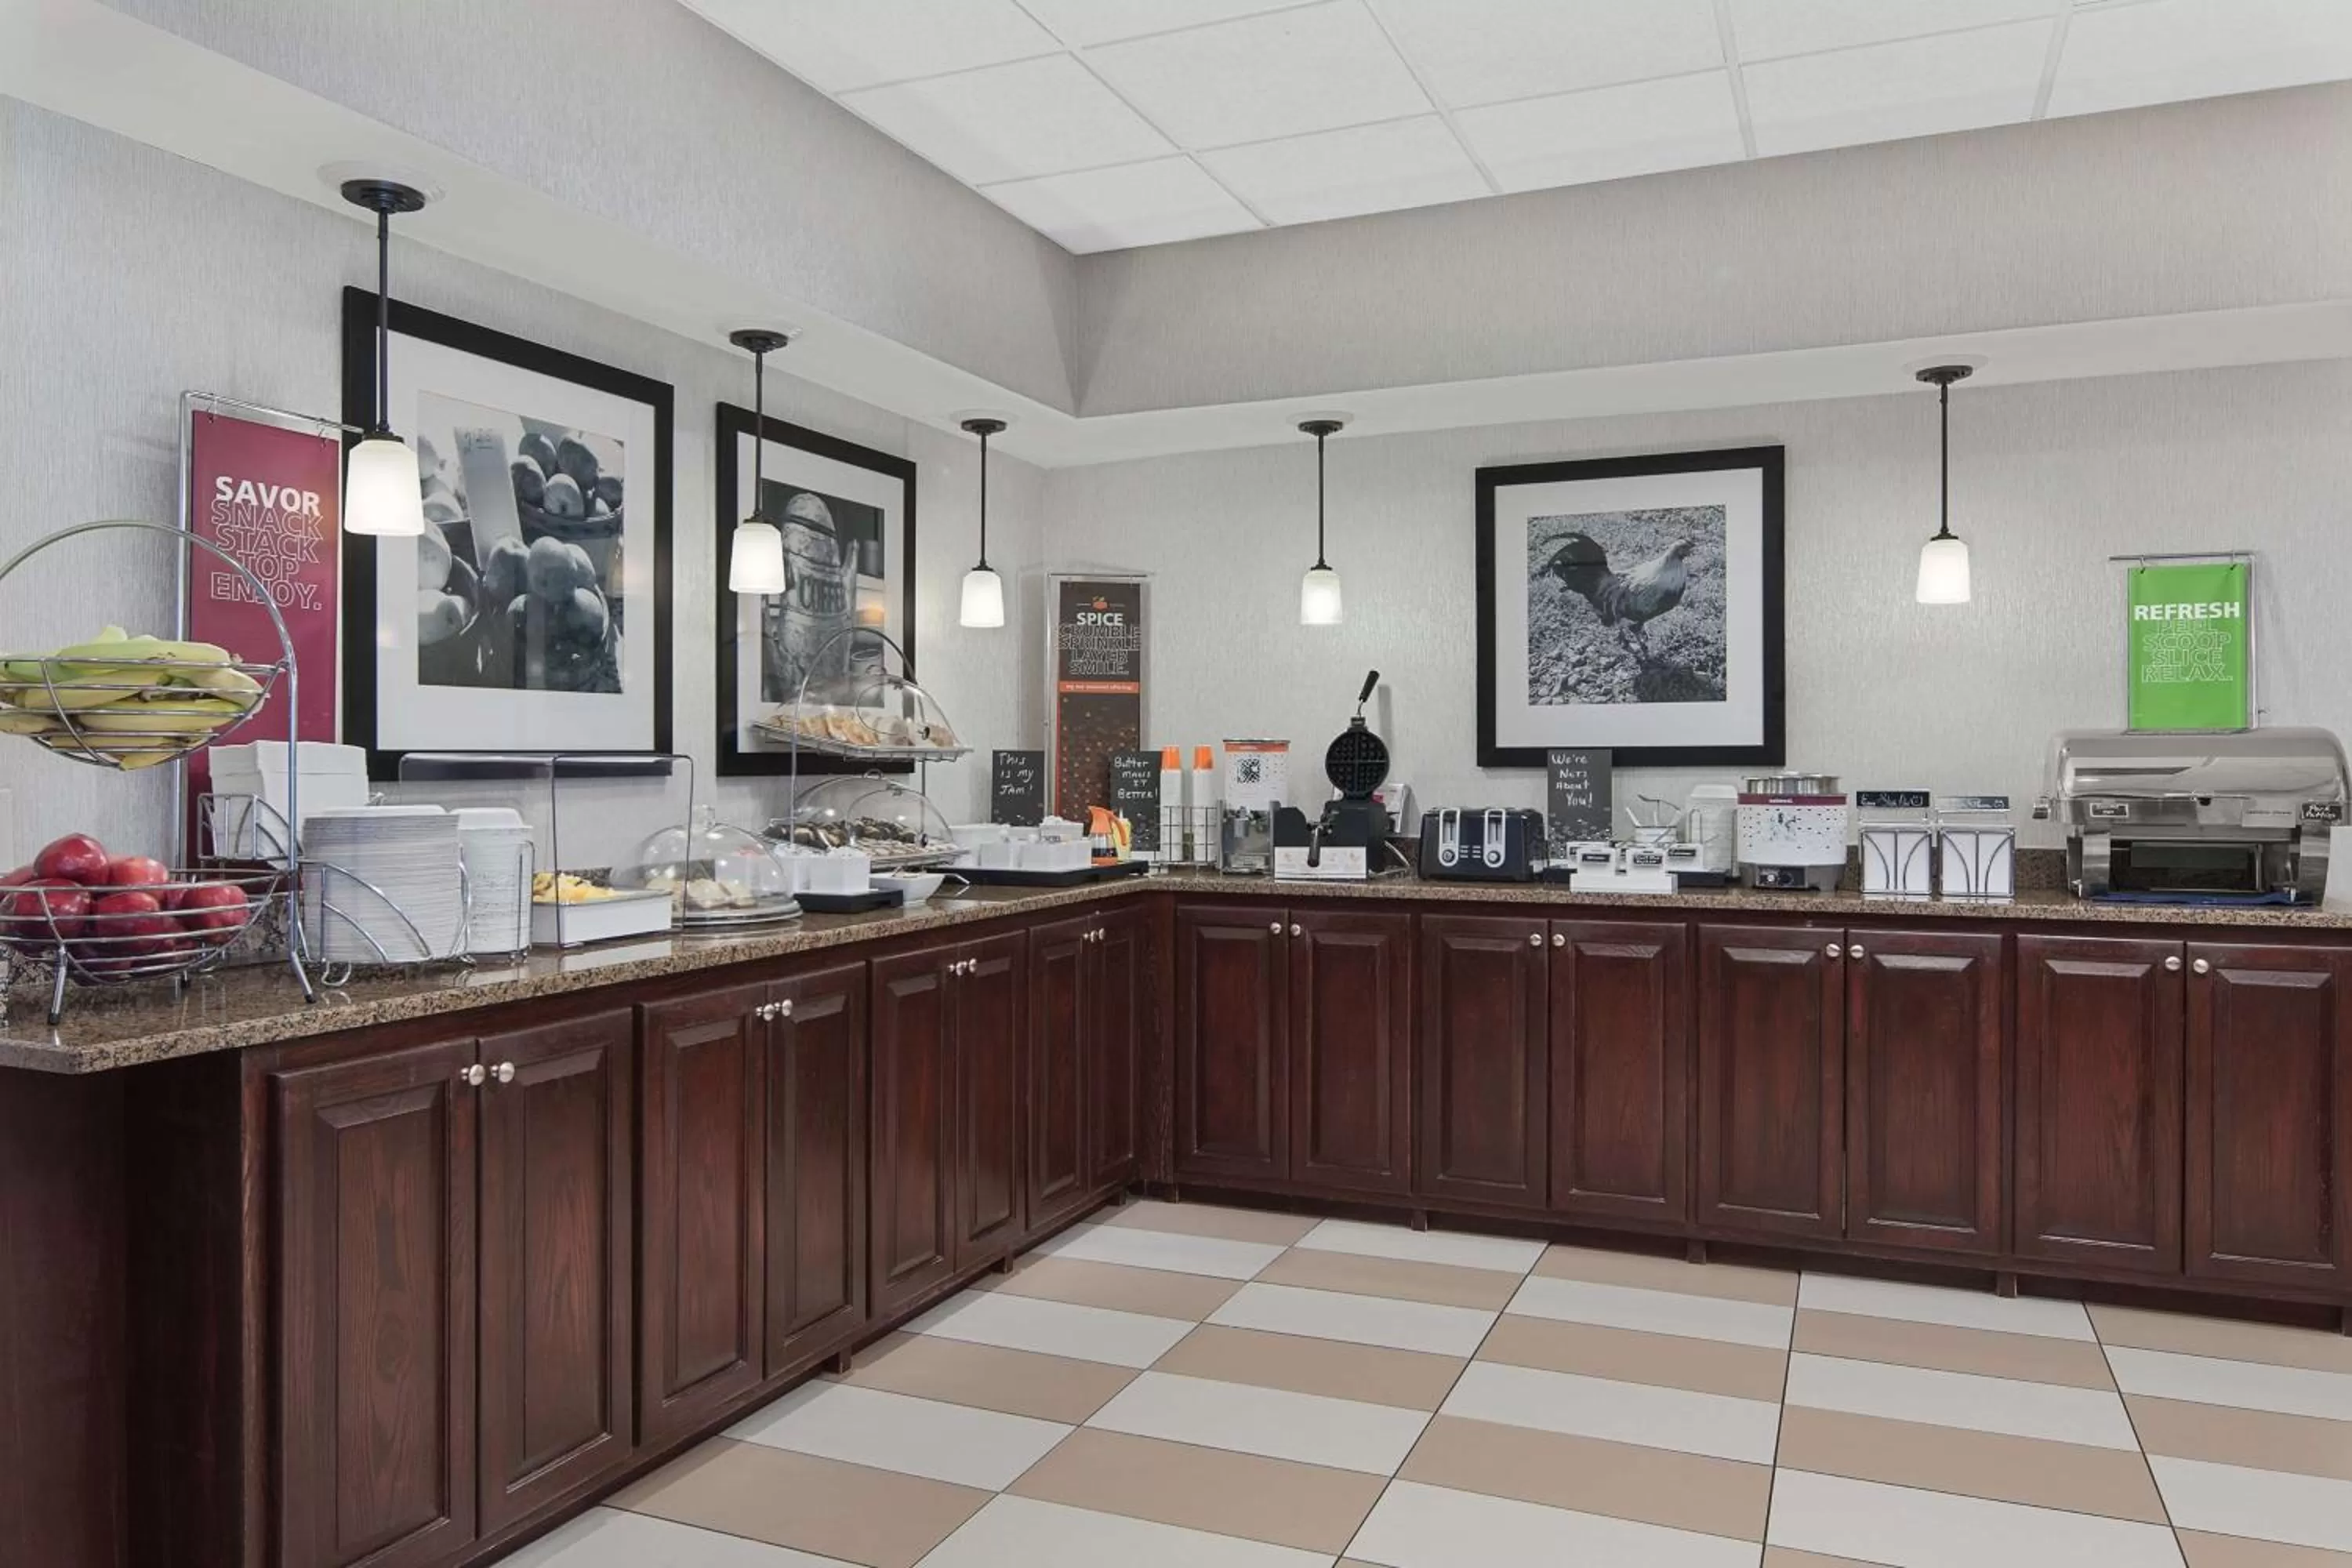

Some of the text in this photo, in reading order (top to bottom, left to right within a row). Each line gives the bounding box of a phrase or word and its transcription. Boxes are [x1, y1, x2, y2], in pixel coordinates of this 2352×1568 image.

[216, 476, 320, 516] SAVOR
[211, 499, 324, 539] SNACK
[216, 524, 319, 564] STACK
[237, 550, 299, 580] TOP
[1076, 612, 1123, 626] SPICE
[2134, 602, 2240, 620] REFRESH
[1054, 636, 1142, 652] SPRINKLE
[2142, 632, 2232, 652] SCOOP
[1070, 649, 1129, 662] LAYER
[2152, 648, 2223, 666] SLICE
[999, 752, 1026, 765] This
[1114, 756, 1149, 768] Butter
[1552, 753, 1588, 764] We're
[1017, 769, 1034, 782] my
